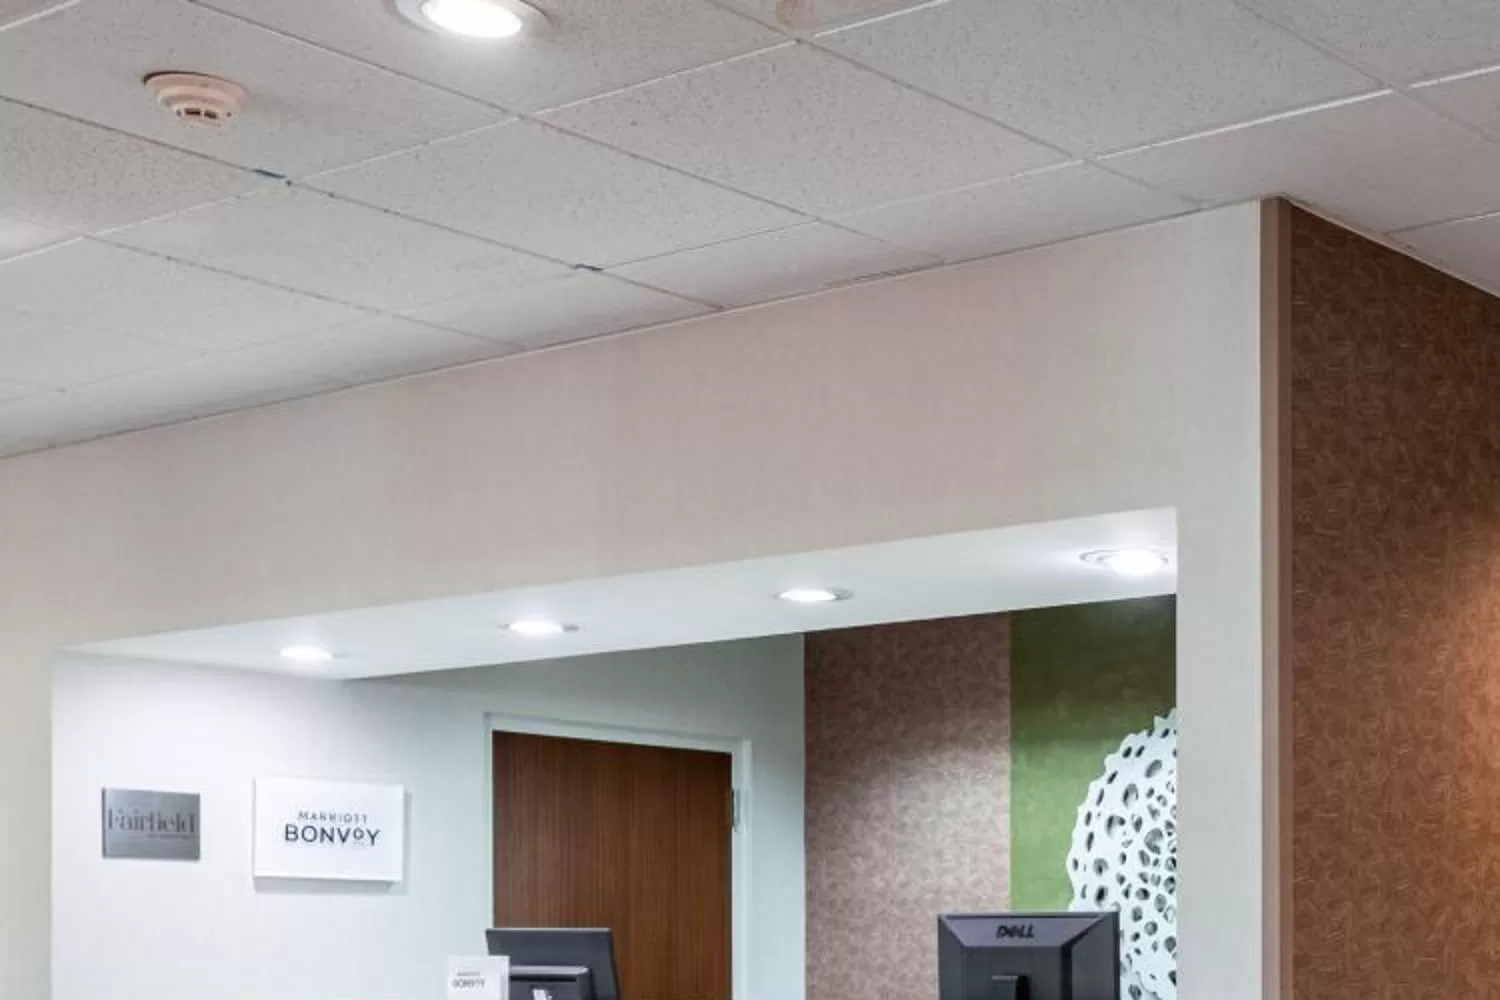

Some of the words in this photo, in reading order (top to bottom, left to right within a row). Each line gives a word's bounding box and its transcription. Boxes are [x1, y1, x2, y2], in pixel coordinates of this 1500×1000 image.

[107, 807, 196, 833] Fairfield
[297, 810, 369, 824] MARRIOTT
[995, 923, 1035, 939] DELL
